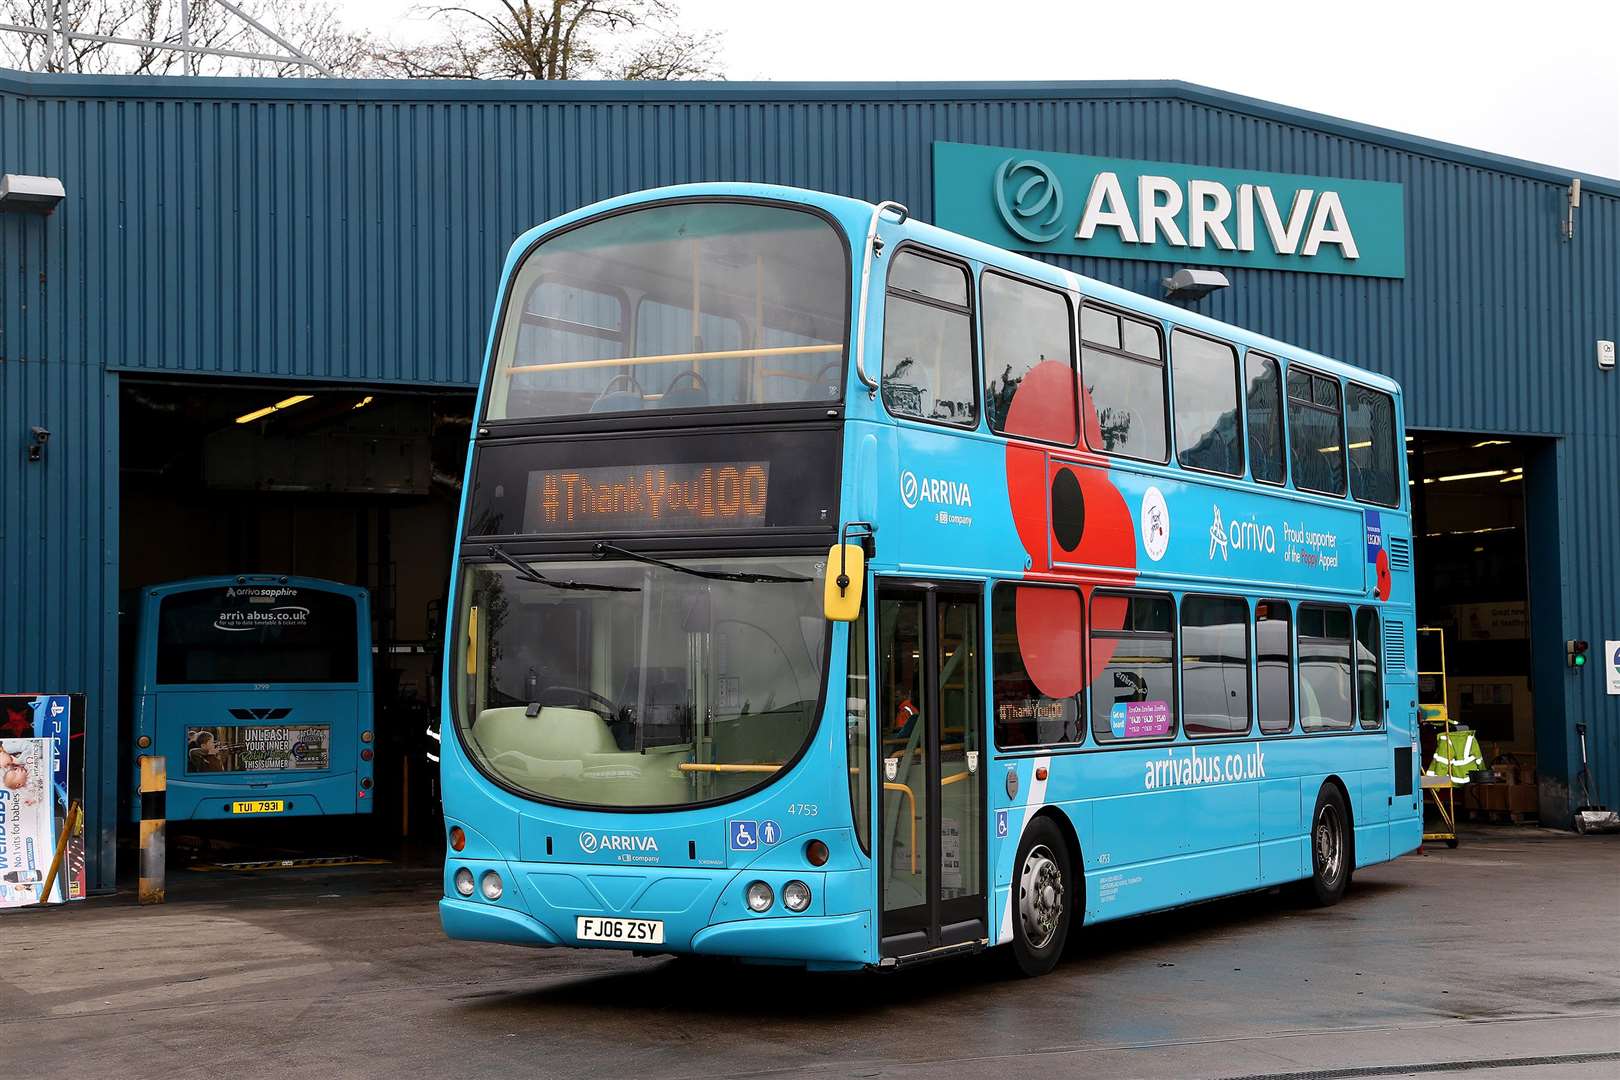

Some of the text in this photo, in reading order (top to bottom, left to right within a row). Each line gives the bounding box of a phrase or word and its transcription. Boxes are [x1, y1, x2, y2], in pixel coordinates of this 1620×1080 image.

[1074, 172, 1360, 259] ARRIVA
[543, 464, 767, 522] #ThankYou100
[920, 478, 972, 507] ARRIVA
[949, 514, 972, 527] company
[1230, 515, 1276, 553] arriva
[1283, 521, 1336, 551] Proud supporter
[1319, 550, 1338, 570] Appeal
[261, 588, 298, 597] sapphire
[245, 729, 289, 741] UNLEASH
[245, 740, 289, 751] YOUR INNER
[244, 760, 289, 768] THIS SUMMER
[1145, 741, 1266, 789] arrivabus.co.uk
[11, 793, 20, 822] babies
[238, 802, 278, 812] TUI 7931
[788, 804, 819, 816] 4753
[11, 823, 19, 835] for
[12, 836, 21, 850] vits
[599, 834, 658, 851] ARRIVA
[632, 855, 660, 863] company
[583, 919, 657, 940] FJ06 ZSY
